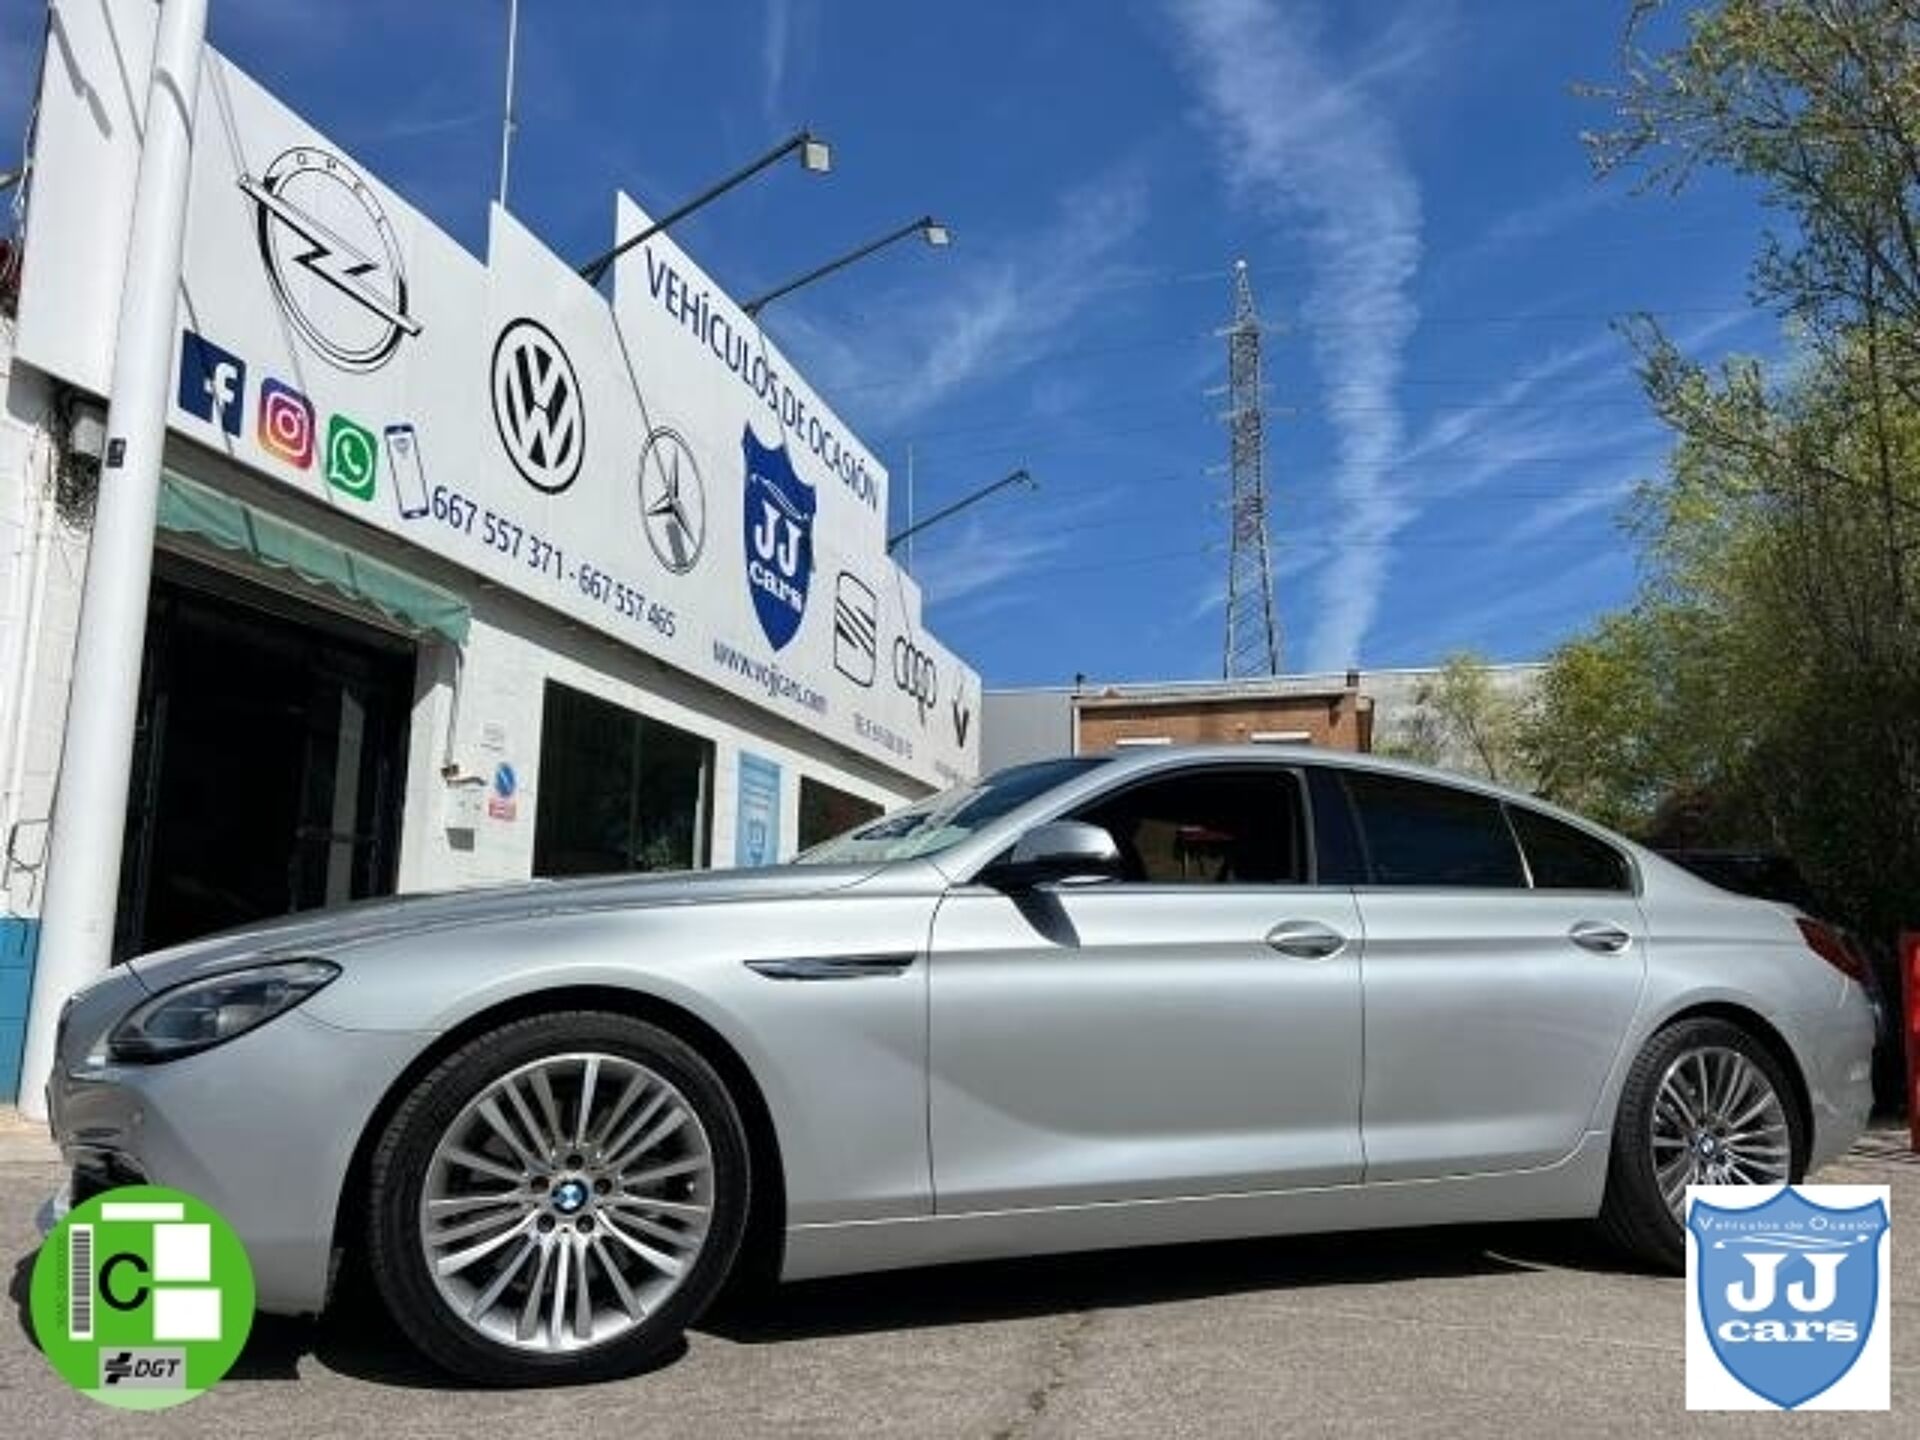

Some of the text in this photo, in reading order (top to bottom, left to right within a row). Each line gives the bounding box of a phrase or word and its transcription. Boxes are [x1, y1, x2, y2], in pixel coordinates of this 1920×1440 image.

[646, 245, 880, 512] VEHÍCULOS DE OCASIÓN
[432, 485, 478, 535] 667
[483, 511, 524, 558] 557
[527, 535, 563, 580] 371
[578, 563, 613, 605] 667
[614, 583, 646, 622] 557
[750, 559, 804, 613] cars
[754, 499, 803, 578] JJ
